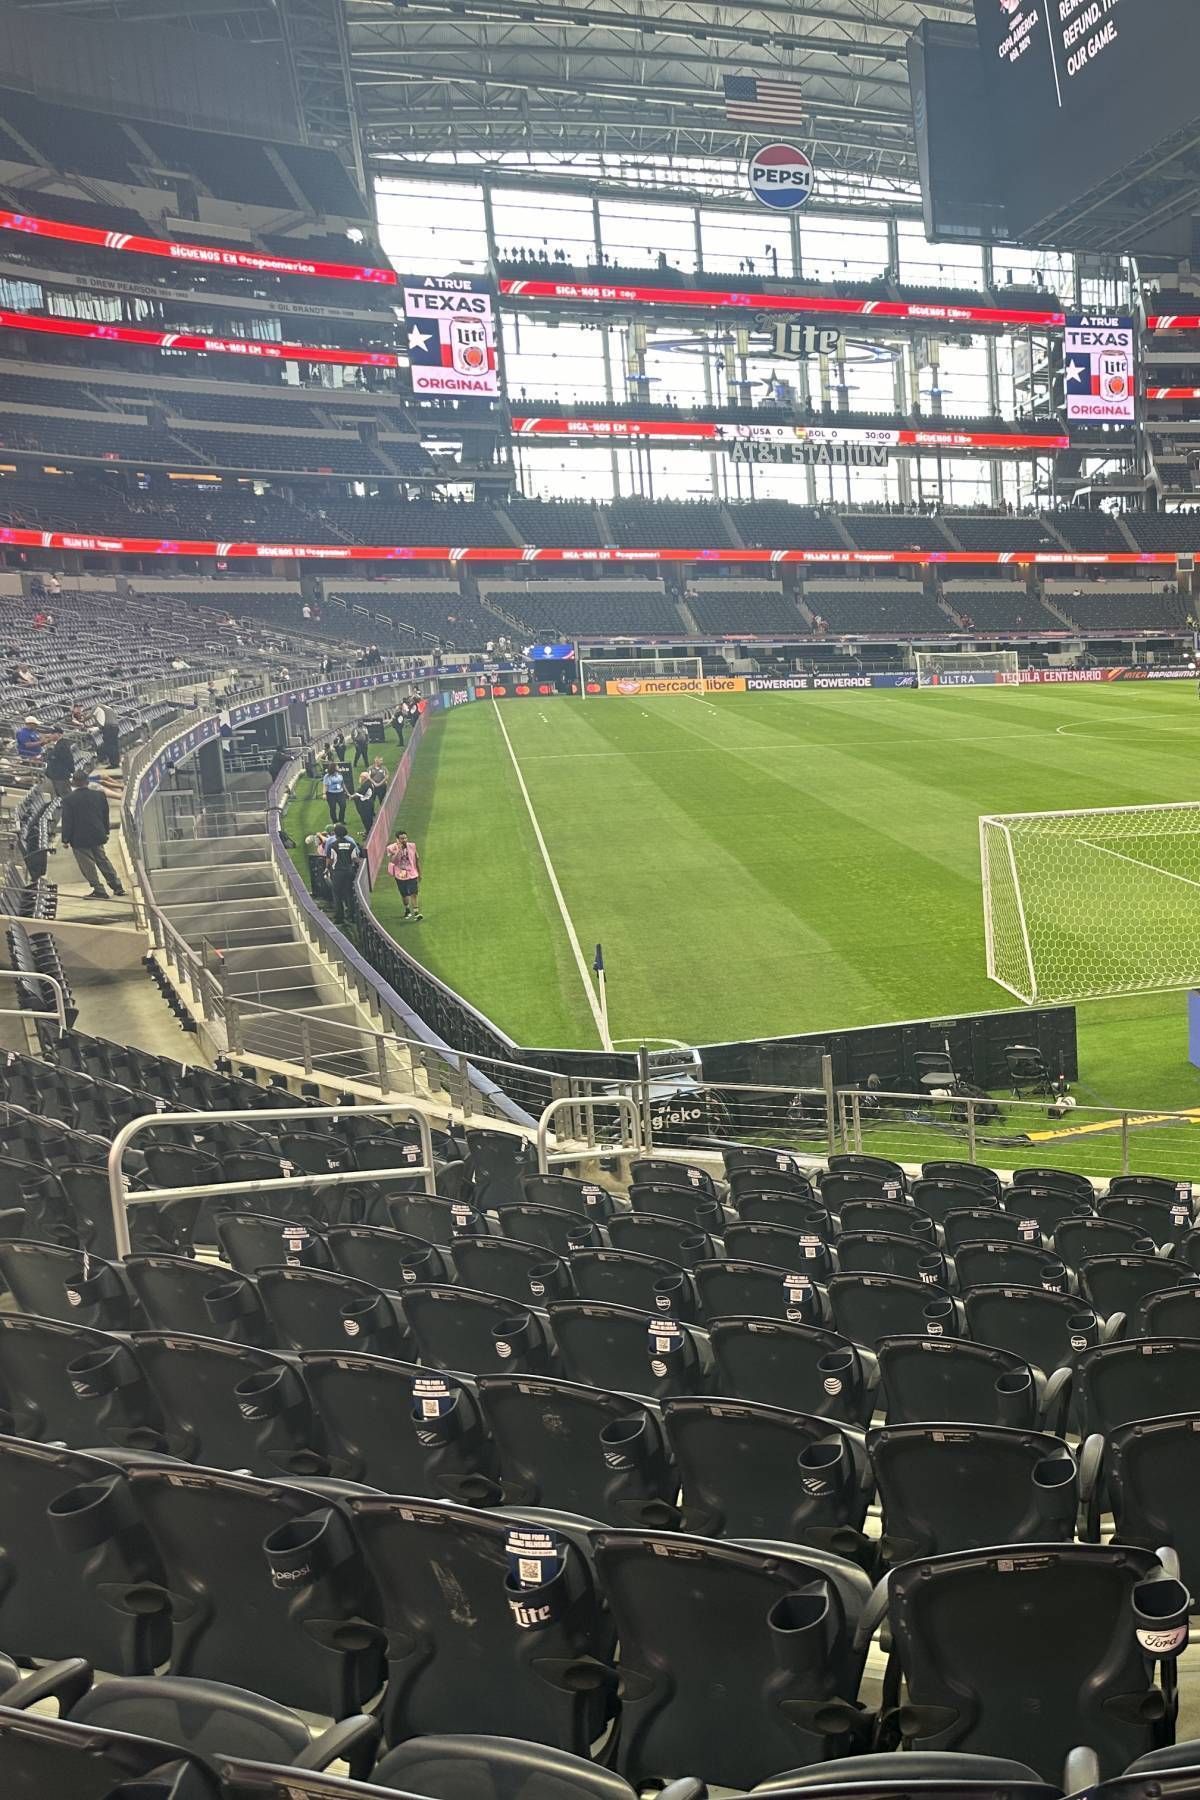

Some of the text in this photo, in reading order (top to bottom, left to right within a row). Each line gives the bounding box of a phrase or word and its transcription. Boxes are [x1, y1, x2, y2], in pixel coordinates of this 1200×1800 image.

[1063, 3, 1101, 49] REFUND.
[999, 35, 1014, 58] COPA
[1067, 21, 1117, 76] OUR GAME.
[752, 167, 810, 187] PEPSI
[170, 244, 220, 262] SÍGUENOS
[222, 253, 238, 265] EN
[90, 278, 116, 290] DREW
[117, 282, 157, 297] PEARSON
[424, 277, 472, 290] A TRUE
[555, 285, 600, 297] SIGA-NOS
[601, 288, 616, 298] EM
[278, 304, 291, 312] GIL
[292, 305, 325, 316] BRANDT
[408, 293, 486, 313] TEXAS
[1080, 317, 1119, 327] A TRUE
[456, 328, 484, 346] Lite
[772, 322, 839, 359] Lite
[1068, 331, 1129, 346] TEXAS
[1105, 361, 1127, 376] Lite
[417, 378, 493, 392] ORIGINAL
[1071, 405, 1131, 415] ORIGINAL
[752, 428, 771, 436] USA
[808, 430, 826, 438] BOL
[865, 431, 891, 440] 30:00
[730, 441, 889, 467] AT&T STADIUM
[814, 677, 871, 688] POWERADE
[939, 674, 975, 685] ULTRA
[1001, 670, 1102, 684] TEQUILA CENTENARIO
[1123, 671, 1146, 679] INTER
[706, 679, 735, 690] libre
[748, 678, 807, 690] POWERADE
[277, 1563, 310, 1583] pepsi
[510, 1603, 551, 1628] Lite
[1144, 1632, 1180, 1648] Ford
